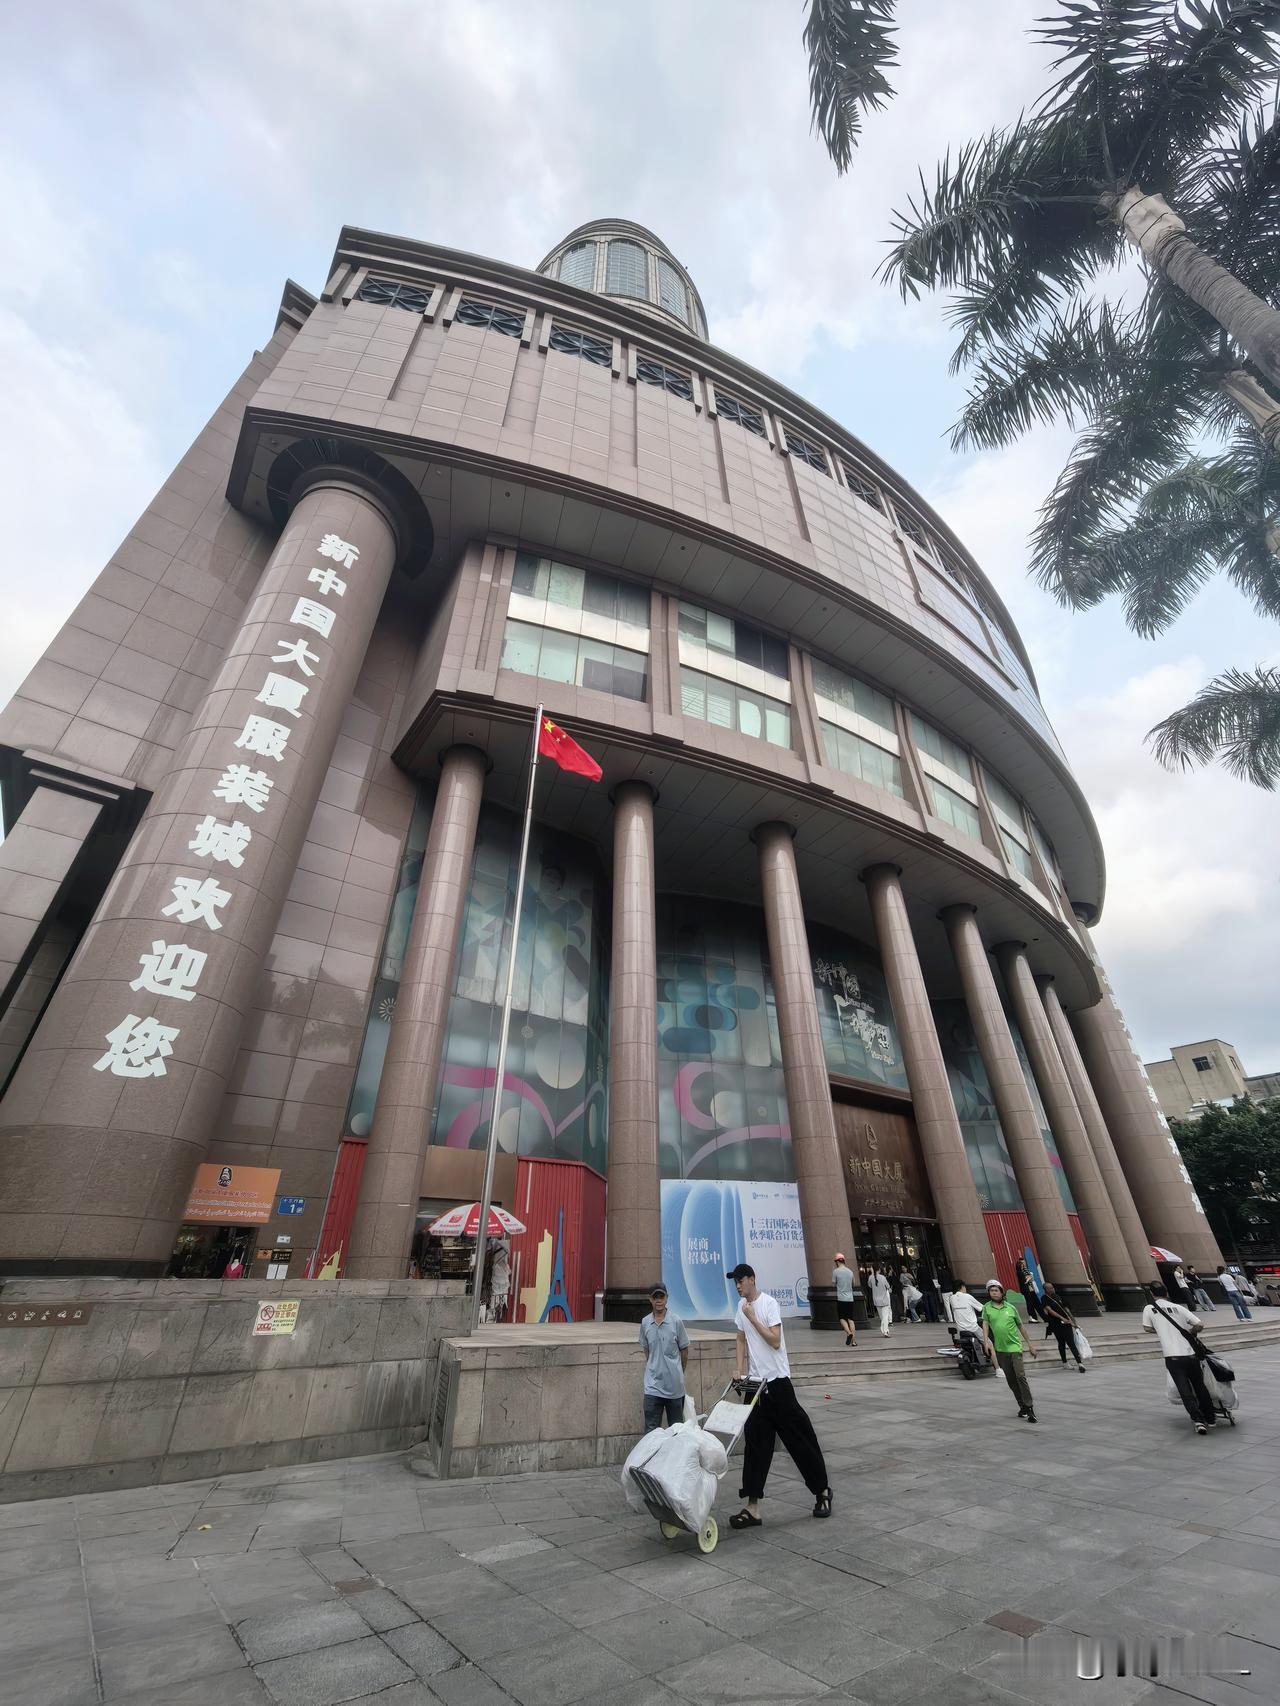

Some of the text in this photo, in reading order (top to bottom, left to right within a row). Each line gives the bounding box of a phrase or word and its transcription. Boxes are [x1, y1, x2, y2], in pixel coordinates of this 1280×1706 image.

[93, 532, 361, 1079] 新中国大厦服装城欢迎您
[688, 1237, 709, 1250] 展商
[687, 1250, 721, 1265] 招募中
